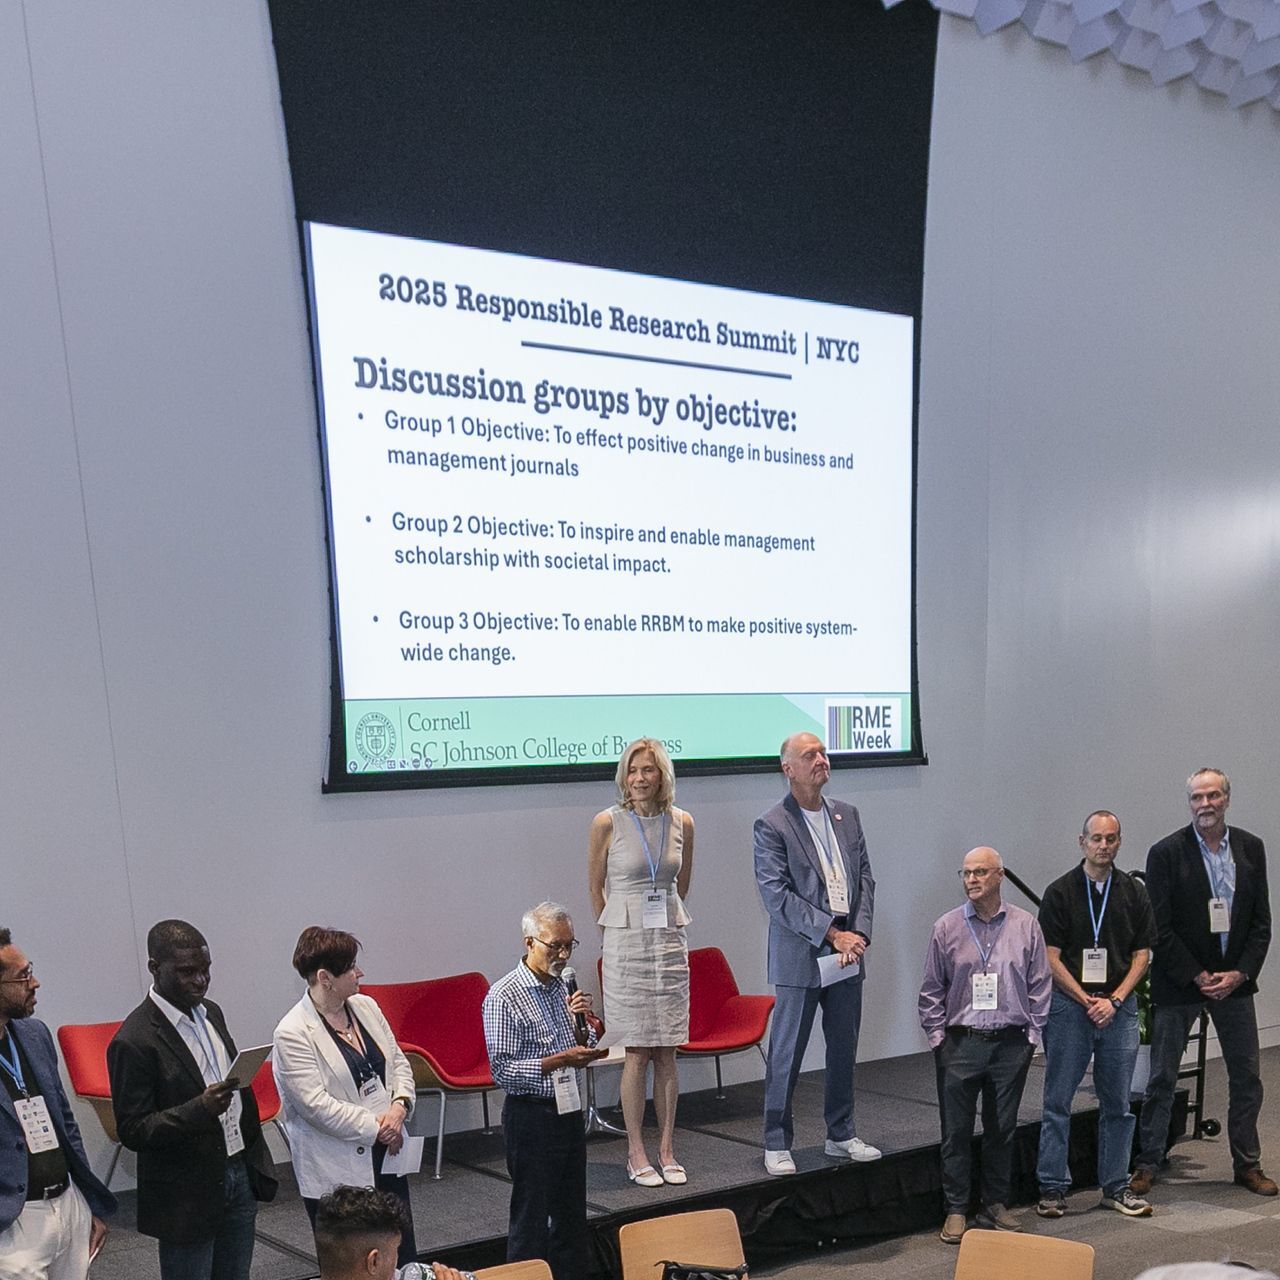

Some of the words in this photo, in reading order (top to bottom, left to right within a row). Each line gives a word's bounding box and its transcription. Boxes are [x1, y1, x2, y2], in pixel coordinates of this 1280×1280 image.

[379, 274, 447, 307] 2025
[455, 284, 602, 328] Responsible
[609, 306, 711, 343] Research
[717, 322, 796, 355] Summit
[817, 337, 859, 363] NYC
[353, 357, 526, 404] Discussion
[534, 380, 629, 419] groups
[635, 388, 669, 425] by
[676, 394, 796, 432] objective:
[385, 410, 442, 437] Group
[448, 416, 455, 434] 1
[462, 417, 549, 442] Objective:
[554, 425, 571, 444] To
[576, 428, 623, 448] effect
[628, 434, 687, 454] positive
[692, 439, 744, 463] change
[748, 443, 760, 461] in
[765, 445, 825, 467] business
[829, 453, 853, 469] and
[388, 450, 507, 472] management
[511, 454, 579, 476] journals
[393, 512, 448, 537] Group
[453, 515, 463, 533] 2
[468, 516, 554, 539] Objective:
[558, 521, 575, 538] To
[581, 522, 634, 544] inspire
[638, 526, 666, 543] and
[671, 528, 720, 546] enable
[725, 535, 815, 553] management
[395, 546, 499, 571] scholarship
[504, 550, 539, 568] with
[545, 552, 609, 570] societal
[613, 554, 670, 576] impact.
[400, 611, 454, 634] Group
[459, 612, 468, 629] 3
[473, 612, 558, 634] Objective:
[562, 613, 580, 630] To
[584, 614, 636, 631] enable
[642, 615, 684, 632] RRBM
[688, 617, 703, 632] to
[707, 617, 745, 633] make
[750, 618, 802, 637] positive
[806, 621, 857, 638] system-
[401, 643, 443, 661] wide
[449, 643, 515, 665] change.
[408, 711, 471, 732] Cornell
[853, 706, 891, 728] RME
[443, 740, 517, 765] Johnson
[523, 737, 586, 762] College
[592, 736, 608, 756] of
[853, 730, 891, 749] Week
